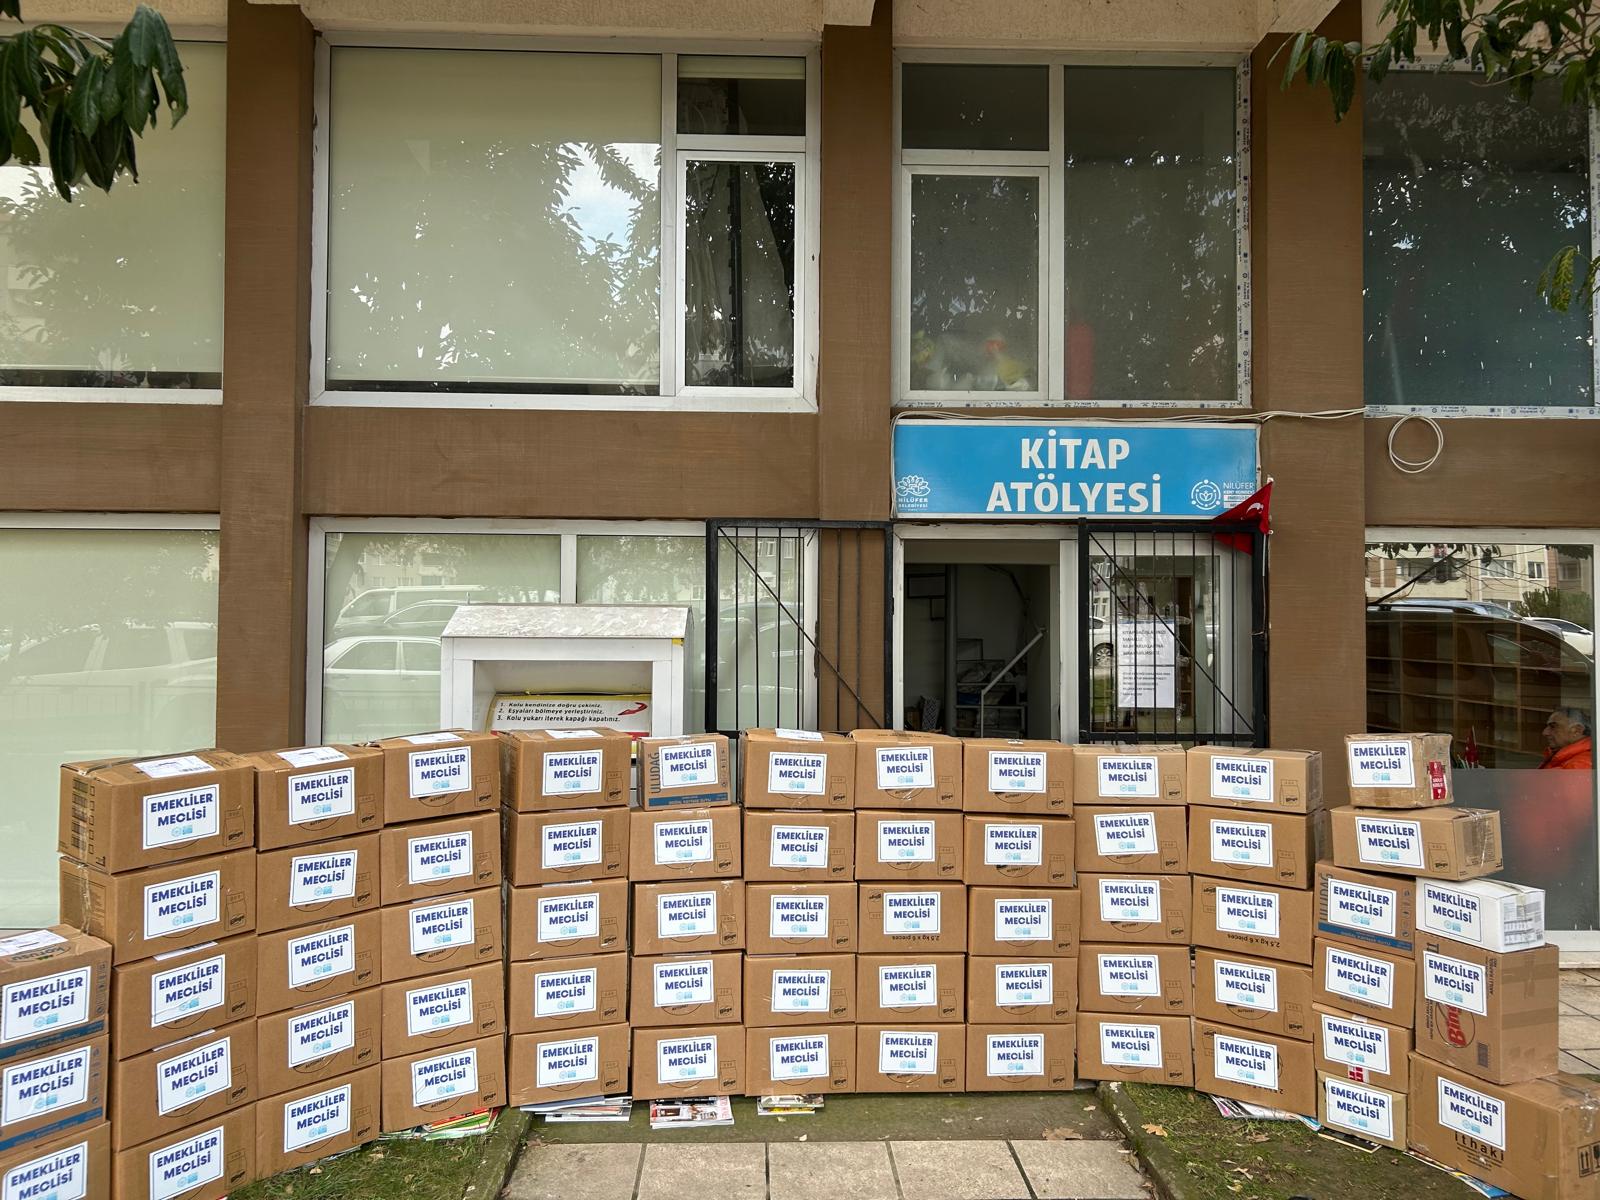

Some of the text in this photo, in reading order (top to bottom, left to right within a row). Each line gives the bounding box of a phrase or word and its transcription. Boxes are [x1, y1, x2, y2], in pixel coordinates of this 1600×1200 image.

[1020, 429, 1130, 470] KİTAP
[985, 473, 1162, 513] ATÖLYESİ
[664, 748, 712, 760] EMEKLİLER
[881, 752, 928, 762] EMEKLİLER
[1353, 745, 1406, 757] EMEKLİLER
[414, 753, 466, 767] EMEKLİLER
[549, 755, 597, 767] EMEKLİLER
[670, 760, 707, 772] MECLİSİ
[774, 757, 822, 768] EMEKLİLER
[994, 756, 1041, 766] EMEKLİLER
[1102, 761, 1152, 771] EMEKLİLER
[1360, 758, 1401, 770] MECLİSİ
[421, 766, 460, 778] MECLİSİ
[554, 767, 592, 779] MECLİSİ
[779, 768, 815, 779] MECLİSİ
[887, 763, 923, 773] MECLİSİ
[999, 767, 1036, 777] MECLİSİ
[1216, 762, 1267, 774] EMEKLİLER
[294, 775, 349, 792] EMEKLİLER
[1108, 772, 1147, 782] MECLİSİ
[1221, 774, 1261, 785] MECLİSİ
[301, 787, 343, 804] MECLİSİ
[150, 792, 214, 813] EMEKLİLER
[157, 808, 206, 826] MECLİSİ
[1099, 818, 1149, 828] EMEKLİLER
[547, 826, 597, 840] EMEKLİLER
[659, 824, 708, 837] EMEKLİLER
[776, 831, 824, 841] EMEKLİLER
[883, 825, 930, 835] EMEKLİLER
[990, 829, 1037, 839] EMEKLİLER
[1106, 828, 1145, 839] MECLİSİ
[1216, 825, 1266, 838] EMEKLİLER
[1361, 823, 1415, 837] EMEKLİLER
[414, 838, 467, 853] EMEKLİLER
[553, 838, 591, 850] MECLİSİ
[665, 837, 702, 847] MECLİSİ
[781, 843, 818, 852] MECLİSİ
[888, 836, 924, 846] MECLİSİ
[995, 840, 1031, 850] MECLİSİ
[1221, 838, 1261, 849] MECLİSİ
[1368, 837, 1410, 849] MECLİSİ
[420, 850, 461, 865] MECLİSİ
[297, 857, 352, 872] EMEKLİLER
[303, 870, 345, 886] MECLİSİ
[151, 880, 214, 903] EMEKLİLER
[1104, 885, 1154, 895] EMEKLİLER
[1333, 884, 1390, 906] EMEKLİLER
[158, 893, 207, 915] MECLİSİ
[543, 899, 594, 913] EMEKLİLER
[663, 897, 711, 909] EMEKLİLER
[776, 901, 823, 910] EMEKLİLER
[888, 897, 935, 907] EMEKLİLER
[1111, 896, 1149, 906] MECLİSİ
[1221, 893, 1273, 908] EMEKLİLER
[1427, 889, 1477, 911] EMEKLİLER
[415, 907, 468, 923] EMEKLİLER
[669, 909, 706, 921] MECLİSİ
[893, 908, 930, 918] MECLİSİ
[999, 905, 1046, 914] EMEKLİLER
[1227, 907, 1267, 920] MECLİSİ
[1339, 900, 1382, 917] MECLİSİ
[1432, 905, 1472, 923] MECLİSİ
[549, 912, 588, 924] MECLİSİ
[781, 911, 818, 922] MECLİSİ
[1005, 915, 1041, 924] MECLİSİ
[422, 919, 463, 935] MECLİSİ
[294, 932, 350, 955] EMEKLİLER
[301, 946, 343, 966] MECLİSİ
[1103, 958, 1153, 969] EMEKLİLER
[1331, 953, 1387, 977] EMEKLİLER
[1428, 958, 1480, 981] EMEKLİLER
[158, 964, 220, 990] EMEKLİLER
[659, 965, 708, 978] EMEKLİLER
[884, 970, 931, 980] EMEKLİLER
[1000, 968, 1047, 979] EMEKLİLER
[1109, 970, 1148, 980] MECLİSİ
[1220, 967, 1271, 982] EMEKLİLER
[540, 974, 591, 988] EMEKLİLER
[665, 977, 703, 989] MECLİSİ
[777, 975, 825, 984] EMEKLİLER
[1005, 979, 1042, 990] MECLİSİ
[1337, 969, 1380, 988] MECLİSİ
[1434, 974, 1474, 993] MECLİSİ
[10, 977, 83, 1004] EMEKLİLER
[165, 978, 213, 1003] MECLİSİ
[546, 986, 585, 999] MECLİSİ
[782, 986, 820, 996] MECLİSİ
[890, 981, 926, 991] MECLİSİ
[1225, 979, 1265, 994] MECLİSİ
[413, 987, 466, 1005] EMEKLİLER
[18, 992, 75, 1017] MECLİSİ
[419, 1000, 461, 1016] MECLİSİ
[294, 1008, 349, 1033] EMEKLİLER
[300, 1023, 343, 1045] MECLİSİ
[1105, 1028, 1155, 1039] EMEKLİLER
[1327, 1022, 1382, 1042] EMEKLİLER
[663, 1042, 712, 1054] EMEKLİLER
[775, 1040, 823, 1052] EMEKLİLER
[885, 1036, 932, 1047] EMEKLİLER
[992, 1039, 1038, 1049] EMEKLİLER
[1111, 1040, 1150, 1051] MECLİSİ
[1334, 1037, 1376, 1054] MECLİSİ
[542, 1044, 593, 1058] EMEKLİLER
[890, 1048, 927, 1058] MECLİSİ
[997, 1050, 1033, 1060] MECLİSİ
[1220, 1041, 1272, 1060] EMEKLİLER
[163, 1047, 224, 1079] EMEKLİLER
[548, 1056, 587, 1070] MECLİSİ
[669, 1054, 707, 1066] MECLİSİ
[781, 1052, 818, 1063] MECLİSİ
[1225, 1056, 1266, 1071] MECLİSİ
[10, 1056, 83, 1085] EMEKLİLER
[418, 1056, 471, 1076] EMEKLİLER
[171, 1062, 218, 1089] MECLİSİ
[424, 1068, 466, 1087] MECLİSİ
[18, 1072, 74, 1099] MECLİSİ
[1330, 1086, 1387, 1108] EMEKLİLER
[1444, 1084, 1499, 1113] EMEKLİLER
[290, 1091, 345, 1118] EMEKLİLER
[1337, 1100, 1379, 1120] MECLİSİ
[296, 1105, 339, 1129] MECLİSİ
[1450, 1102, 1492, 1126] MECLİSİ
[156, 1135, 219, 1168] EMEKLİLER
[1454, 1131, 1504, 1161] ithaki
[10, 1152, 80, 1183] EMEKLİLER
[164, 1152, 211, 1179] MECLİSİ
[18, 1169, 73, 1200] MECLİSİ
